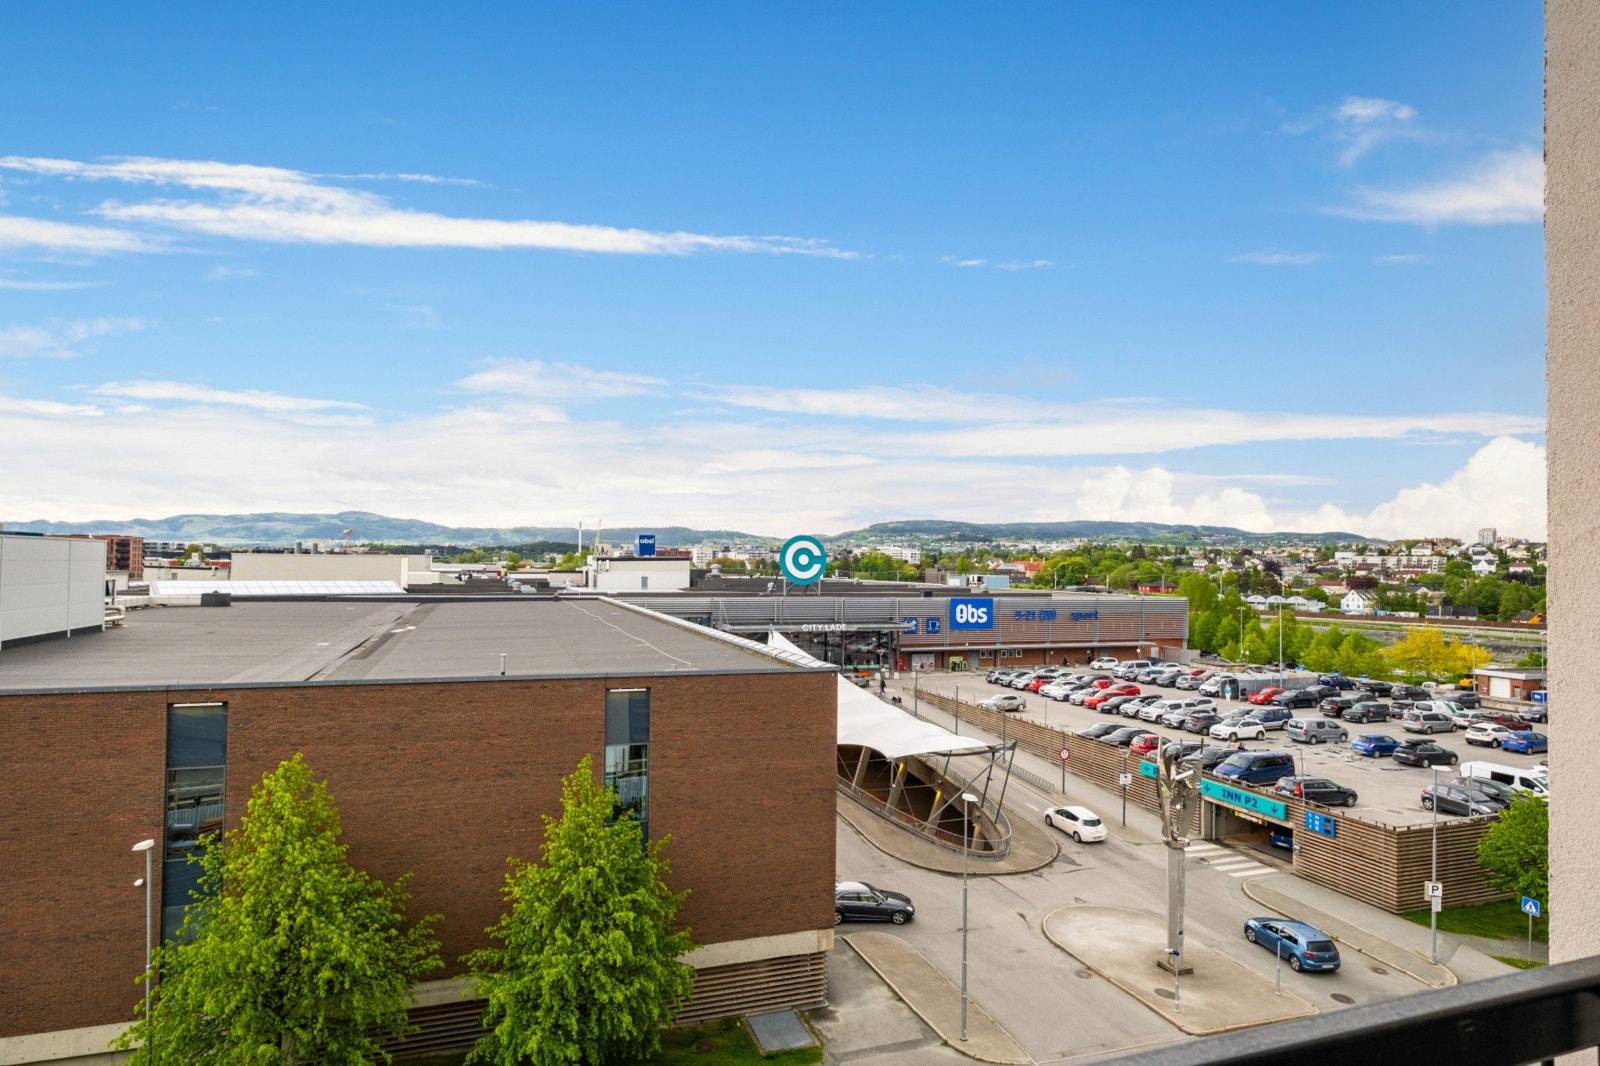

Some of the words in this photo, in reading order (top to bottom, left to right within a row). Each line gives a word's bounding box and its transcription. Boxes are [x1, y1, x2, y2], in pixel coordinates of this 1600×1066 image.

[955, 603, 988, 624] Obs
[1070, 609, 1099, 621] sport
[802, 623, 823, 632] CITY
[824, 623, 847, 631] LADE
[1221, 788, 1241, 803] INN
[1245, 795, 1258, 808] P2
[1431, 884, 1439, 894] P
